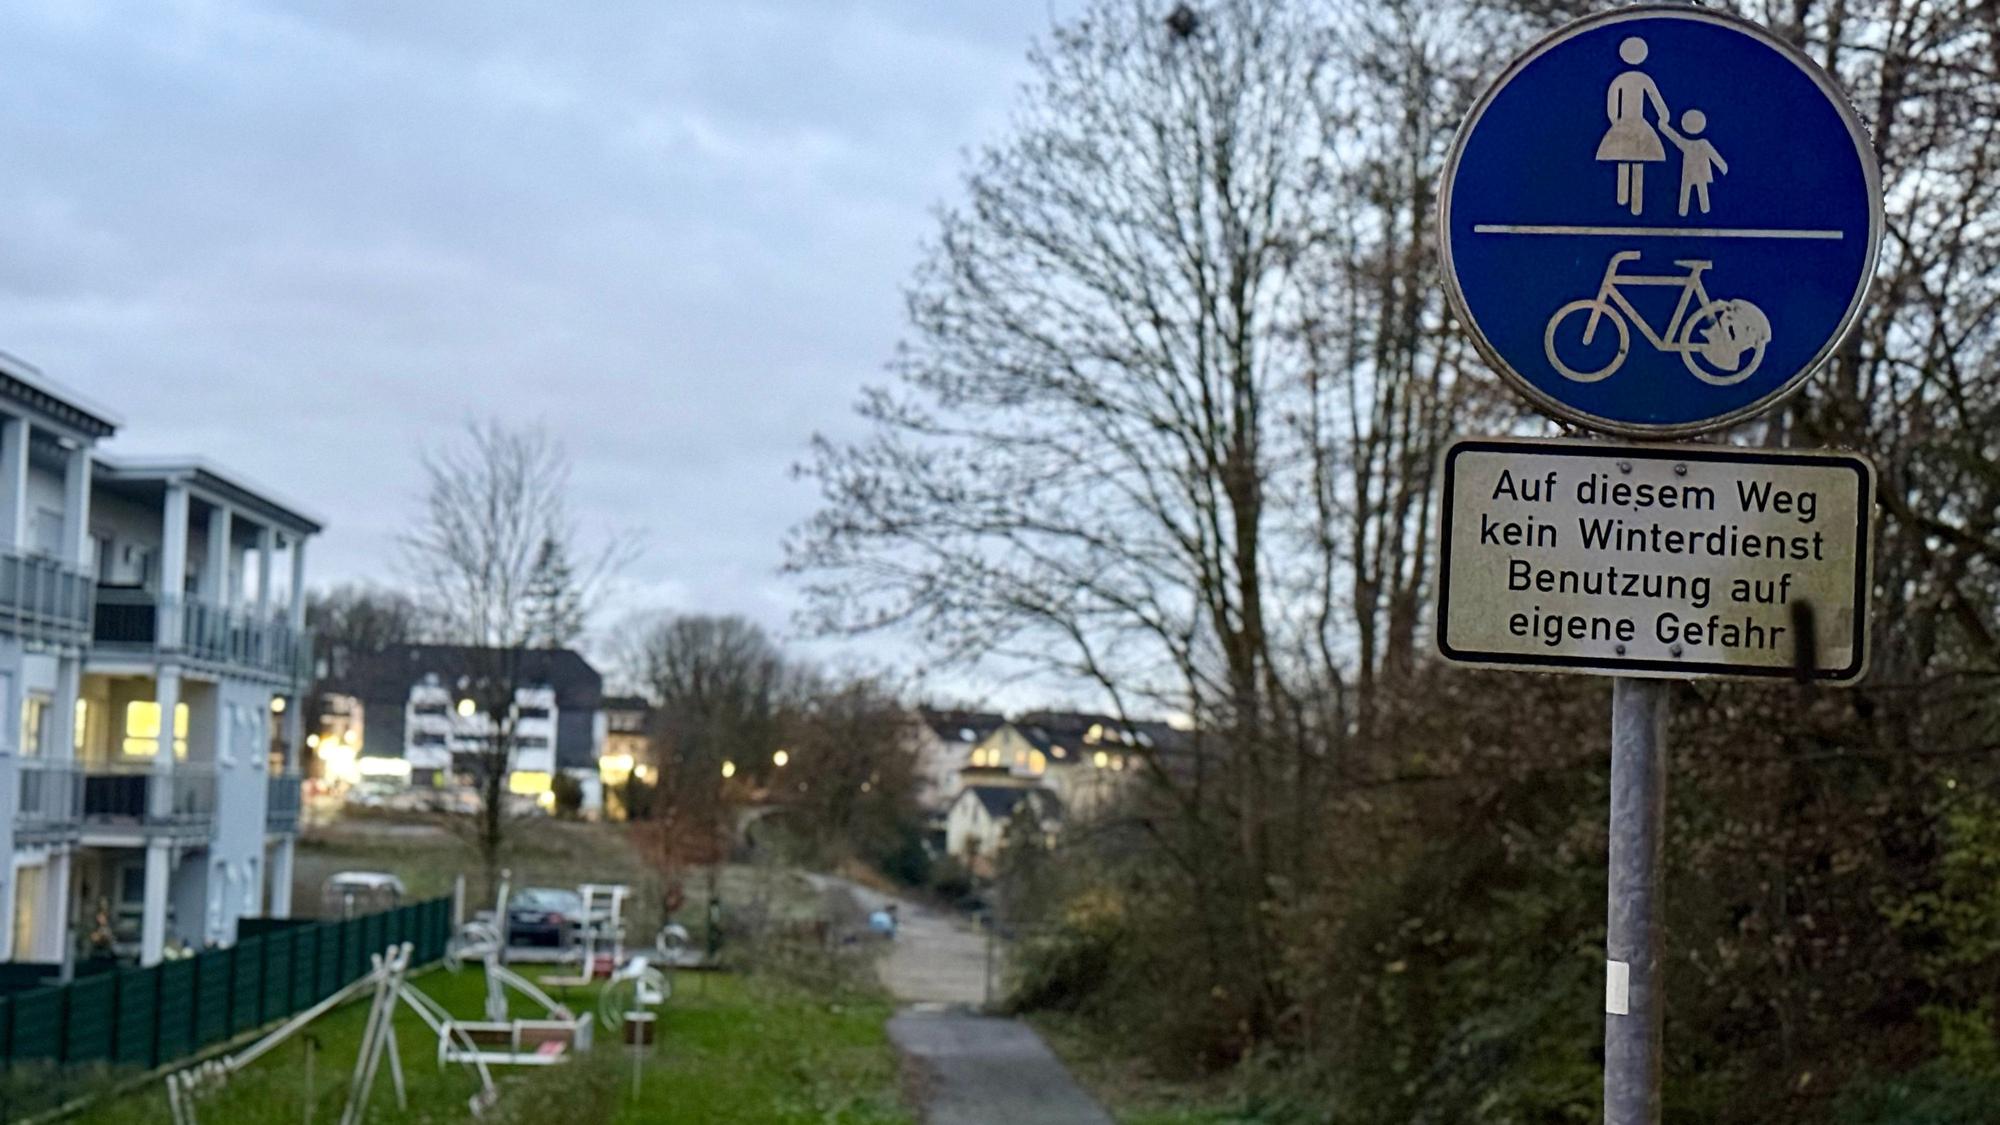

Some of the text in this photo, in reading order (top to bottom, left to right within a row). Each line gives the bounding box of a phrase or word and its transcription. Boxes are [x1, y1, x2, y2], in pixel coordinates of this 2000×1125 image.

[1492, 469, 1818, 523] Auf diesem Weg
[1480, 513, 1824, 561] kein Winterdienst
[1508, 559, 1792, 609] Benutzung auf
[1509, 606, 1787, 650] eigene Gefahr
